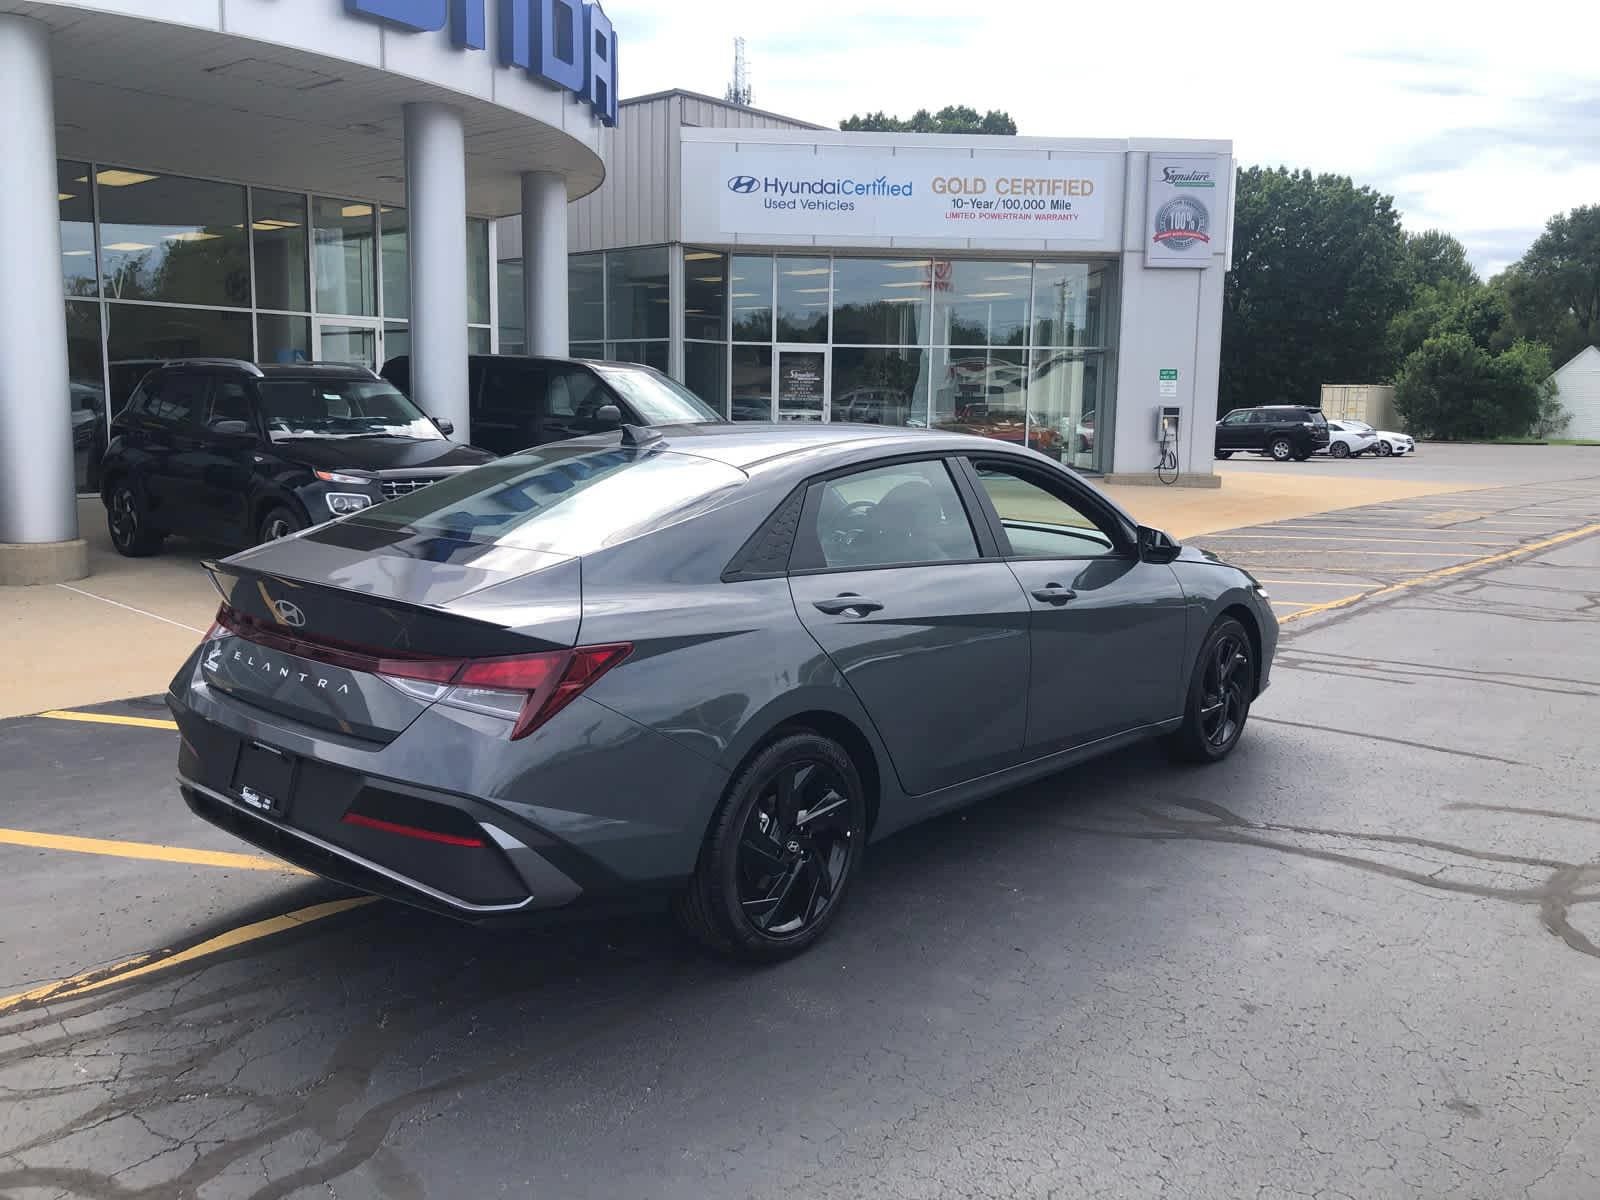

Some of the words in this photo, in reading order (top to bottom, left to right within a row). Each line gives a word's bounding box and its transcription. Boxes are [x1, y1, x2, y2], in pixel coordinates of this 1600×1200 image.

[1162, 166, 1210, 185] Signature
[764, 176, 913, 197] HyundaiCertified
[931, 177, 987, 195] GOLD
[995, 178, 1094, 197] CERTIFIED
[764, 198, 796, 210] Used
[800, 199, 855, 211] Vehicles
[951, 198, 1046, 211] 10-Year/100,000
[1050, 199, 1072, 211] Mile
[945, 212, 976, 220] LIMITED
[979, 212, 1032, 221] POWERTRAIN
[1035, 213, 1079, 221] WARRANTY
[1169, 211, 1196, 230] 100%
[233, 651, 348, 694] ELANTRA
